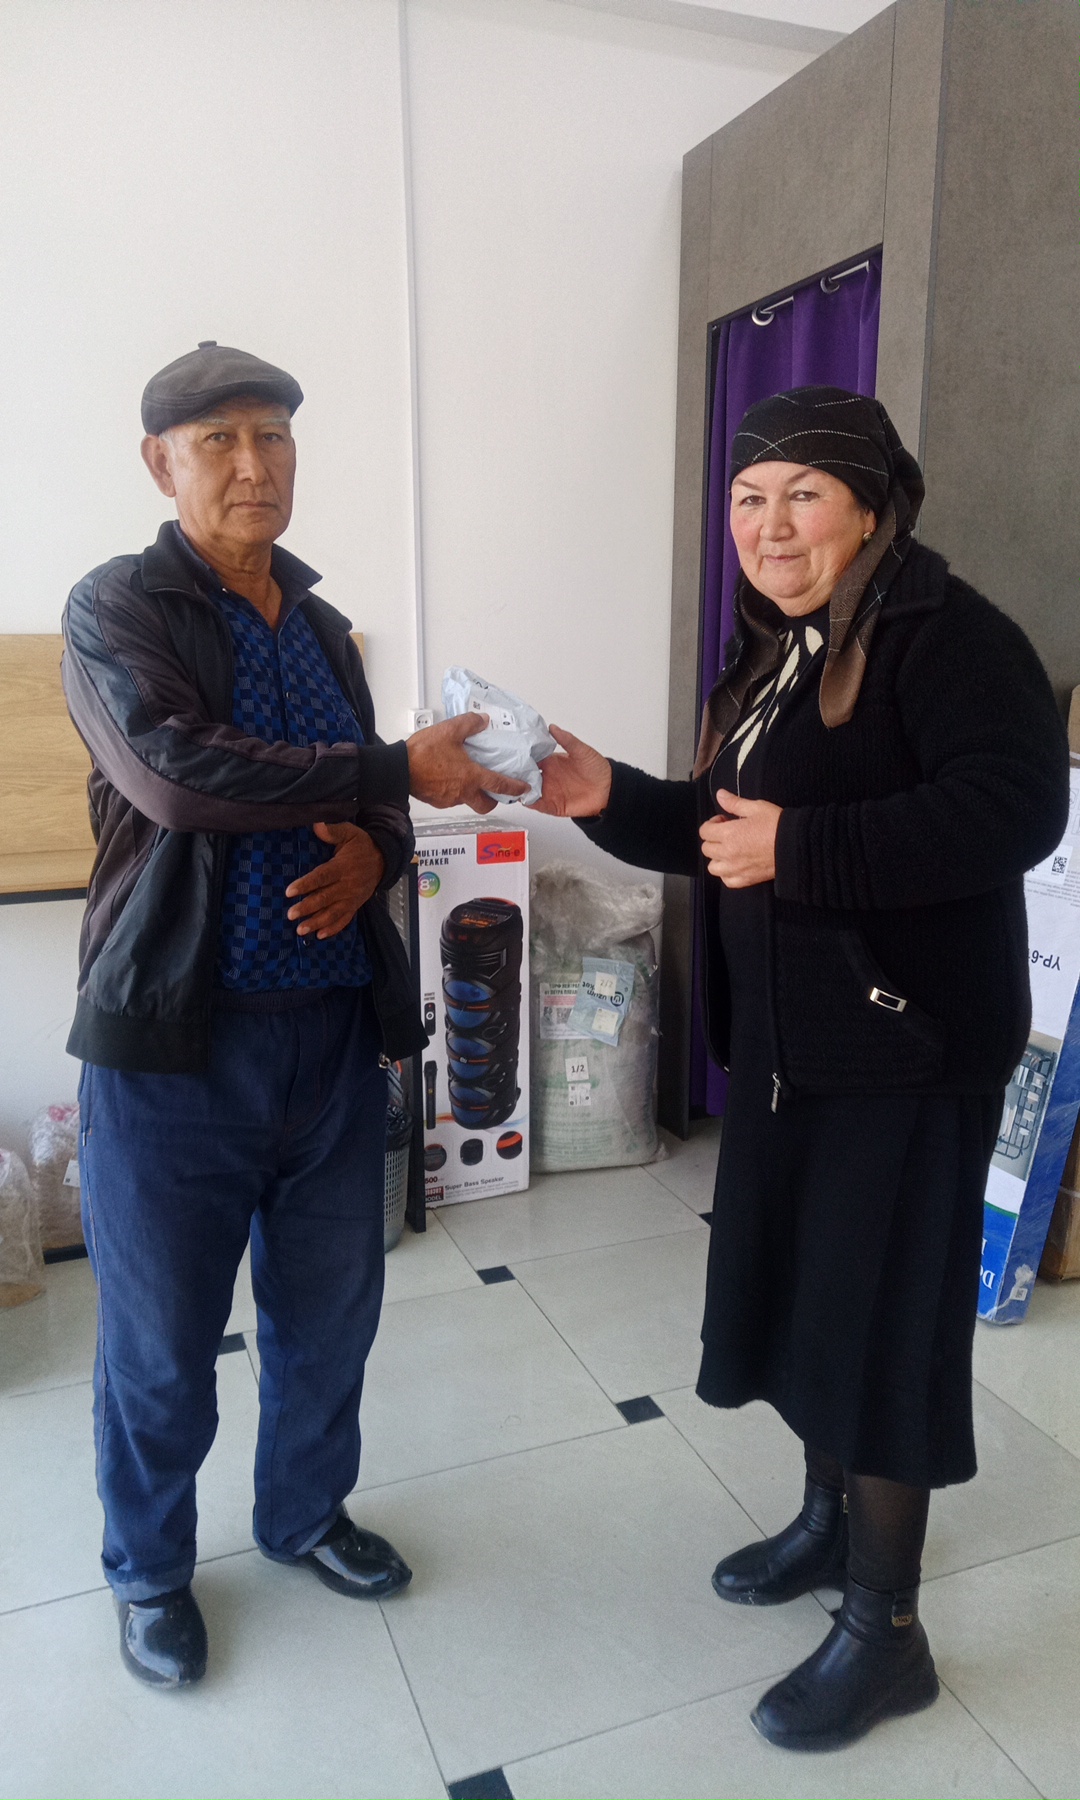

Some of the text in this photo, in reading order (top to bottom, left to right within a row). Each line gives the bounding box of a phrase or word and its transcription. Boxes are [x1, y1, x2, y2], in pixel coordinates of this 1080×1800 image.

[418, 858, 449, 866] PEAKER
[1028, 949, 1061, 971] YP-6
[571, 1064, 585, 1073] 1/2
[445, 1183, 462, 1191] Super
[481, 1176, 504, 1184] Speaker
